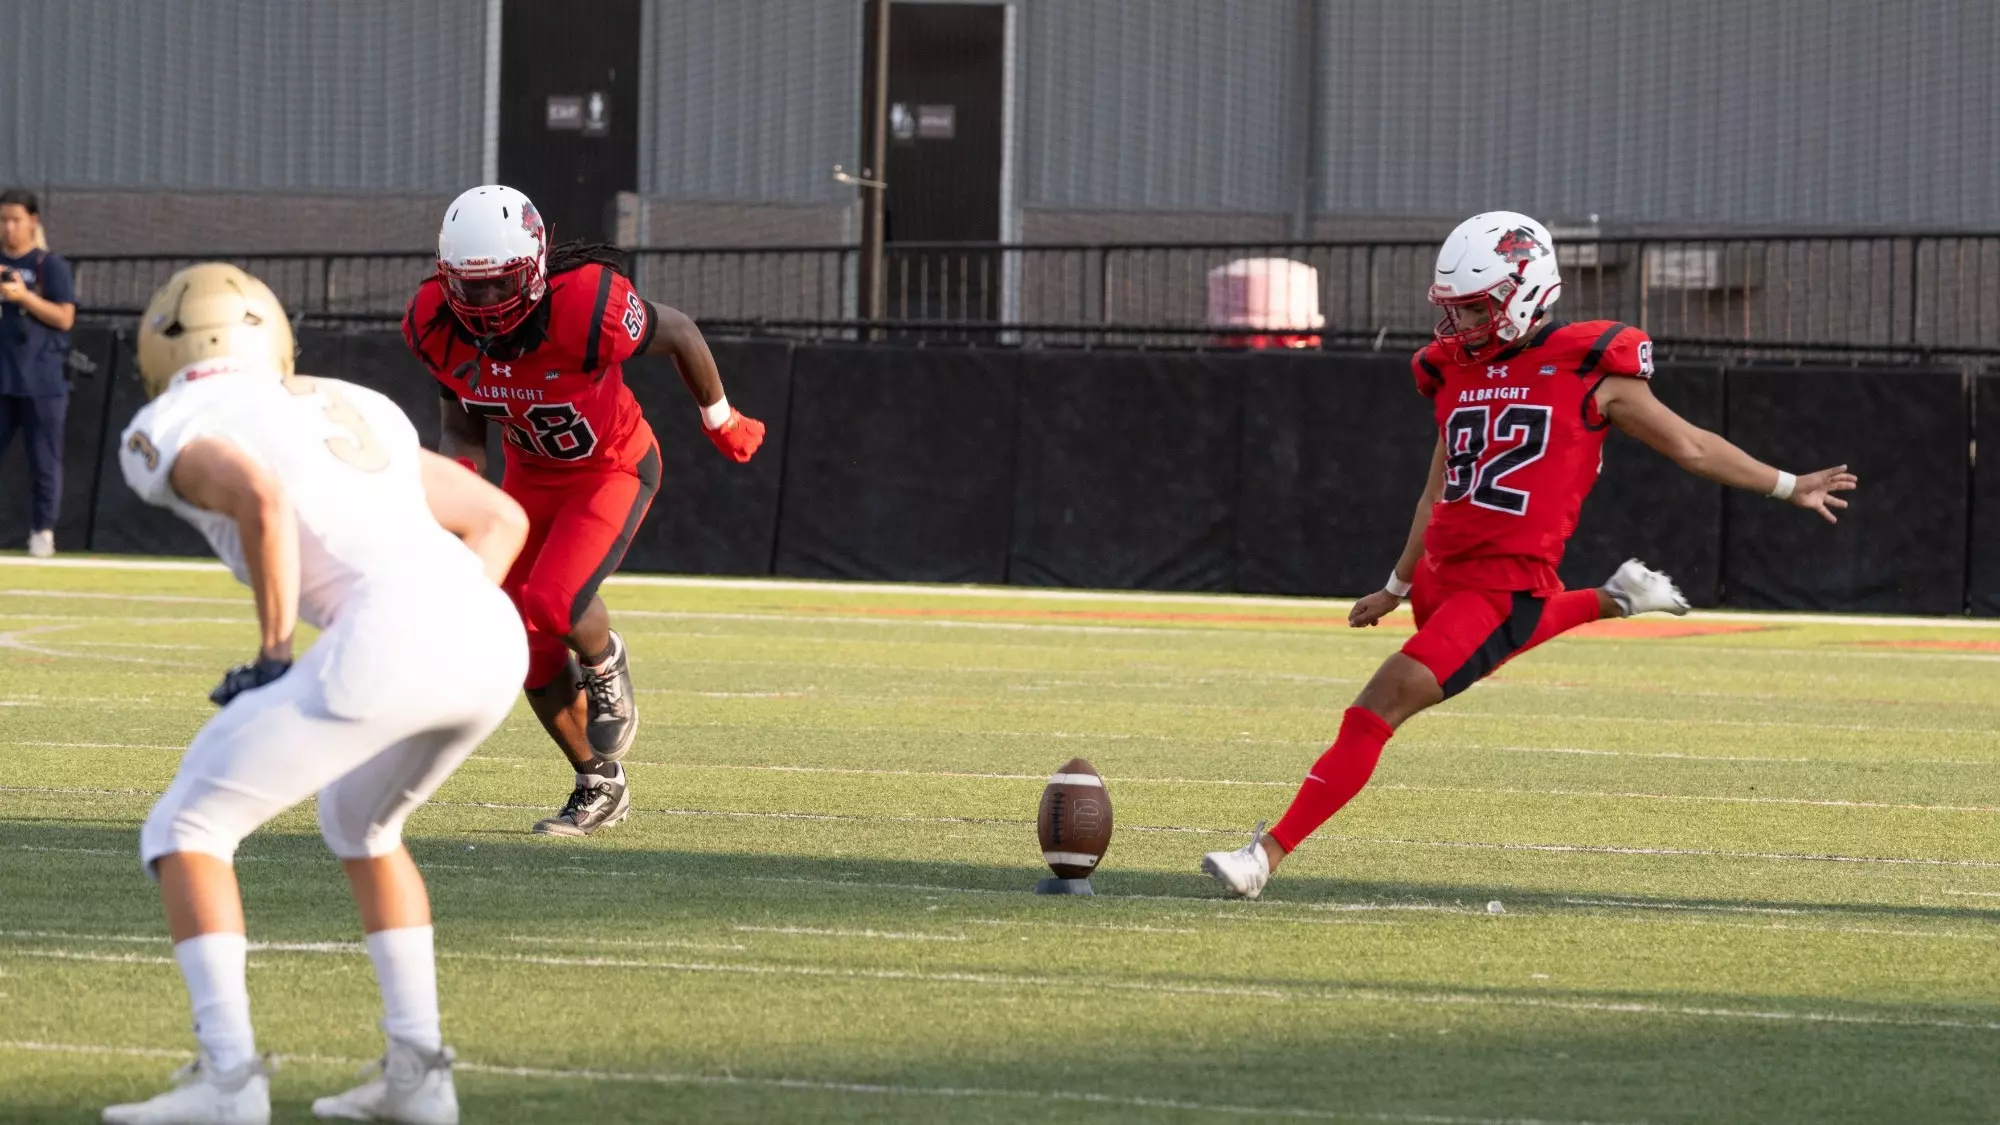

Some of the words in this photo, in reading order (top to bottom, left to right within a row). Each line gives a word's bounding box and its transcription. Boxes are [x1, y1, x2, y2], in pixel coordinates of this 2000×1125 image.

[474, 386, 544, 401] ALBRIGHT
[1459, 387, 1529, 402] ALBRIGHT
[1442, 404, 1553, 516] 82
